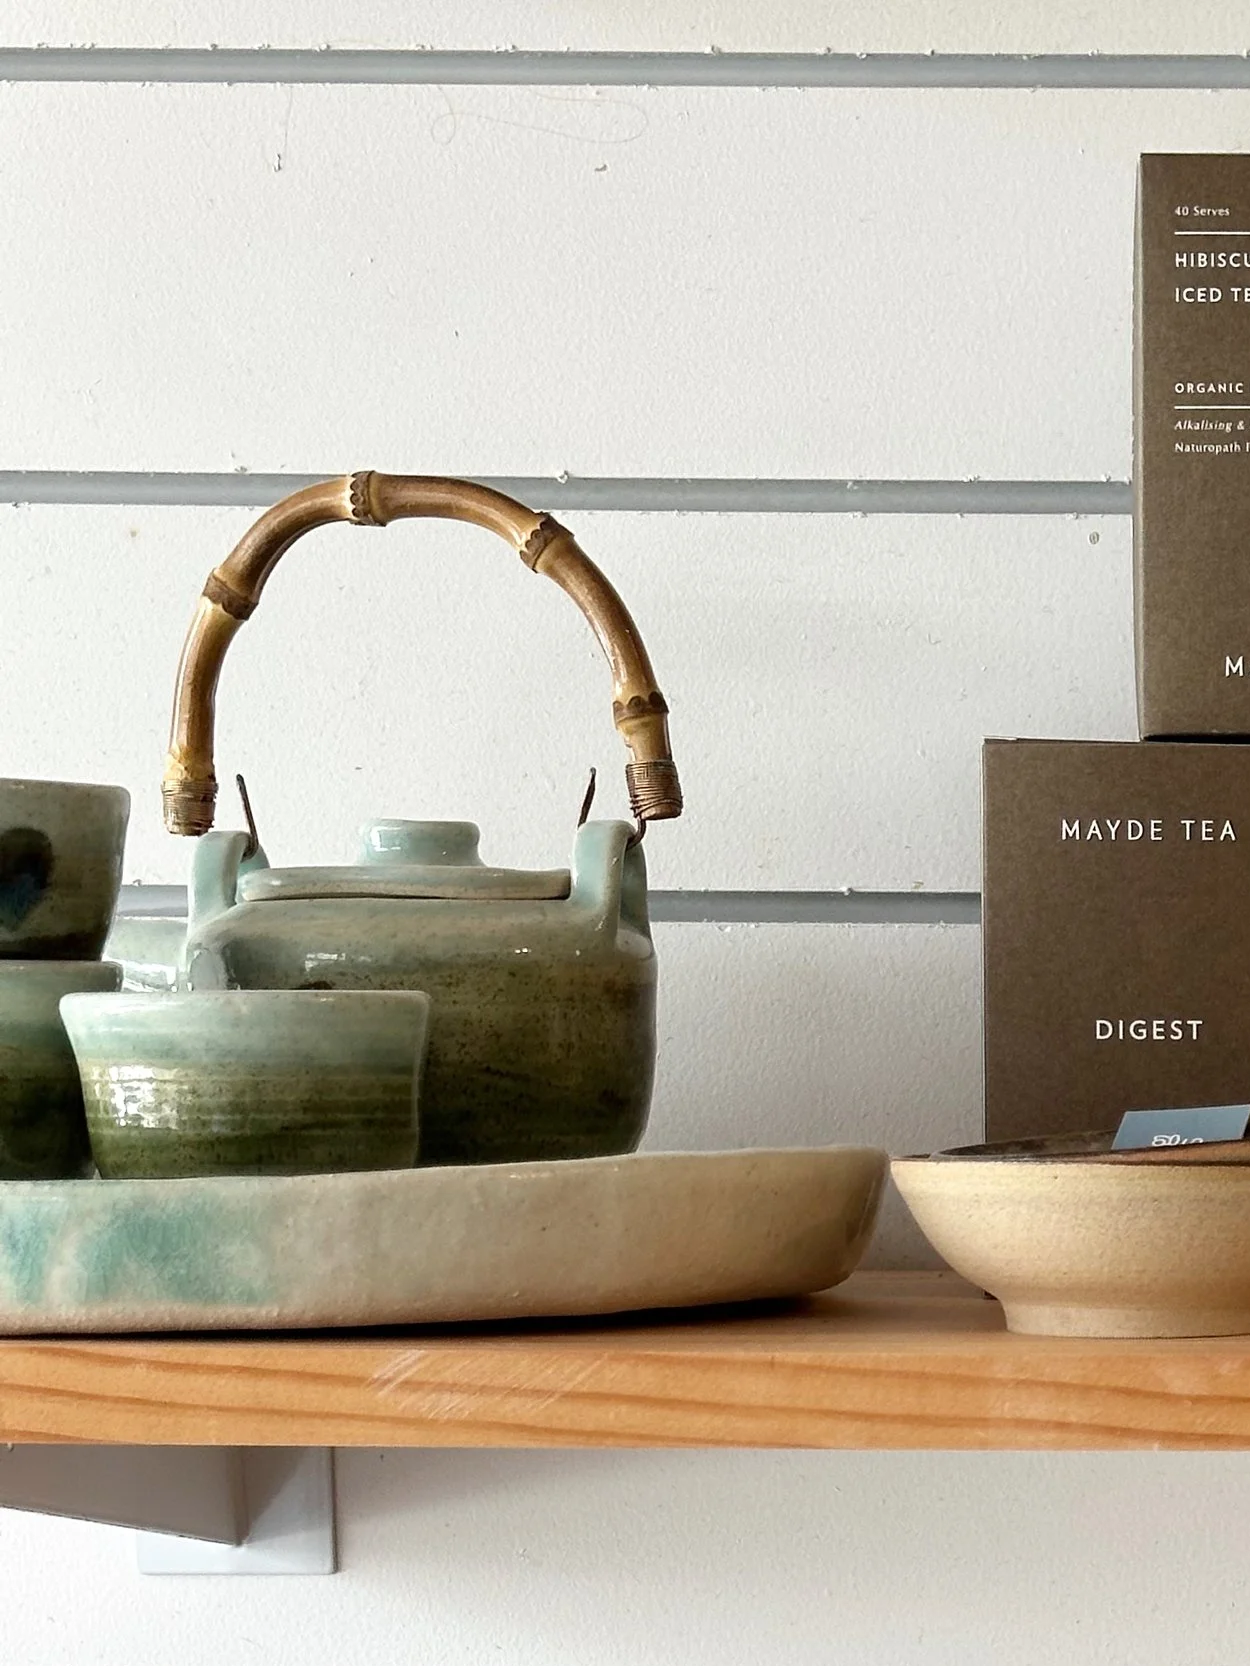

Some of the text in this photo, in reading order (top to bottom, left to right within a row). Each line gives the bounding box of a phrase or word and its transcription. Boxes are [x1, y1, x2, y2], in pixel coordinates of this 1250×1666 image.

[1174, 206, 1230, 217] 40 Serves
[1175, 287, 1222, 303] ICED
[1175, 382, 1244, 394] ORGANIC
[1174, 420, 1232, 433] Alkalising
[1237, 421, 1245, 430] &
[1175, 441, 1241, 455] Naturopath
[1061, 819, 1237, 841] MAYDE TEA
[1096, 1019, 1203, 1040] DIGEST
